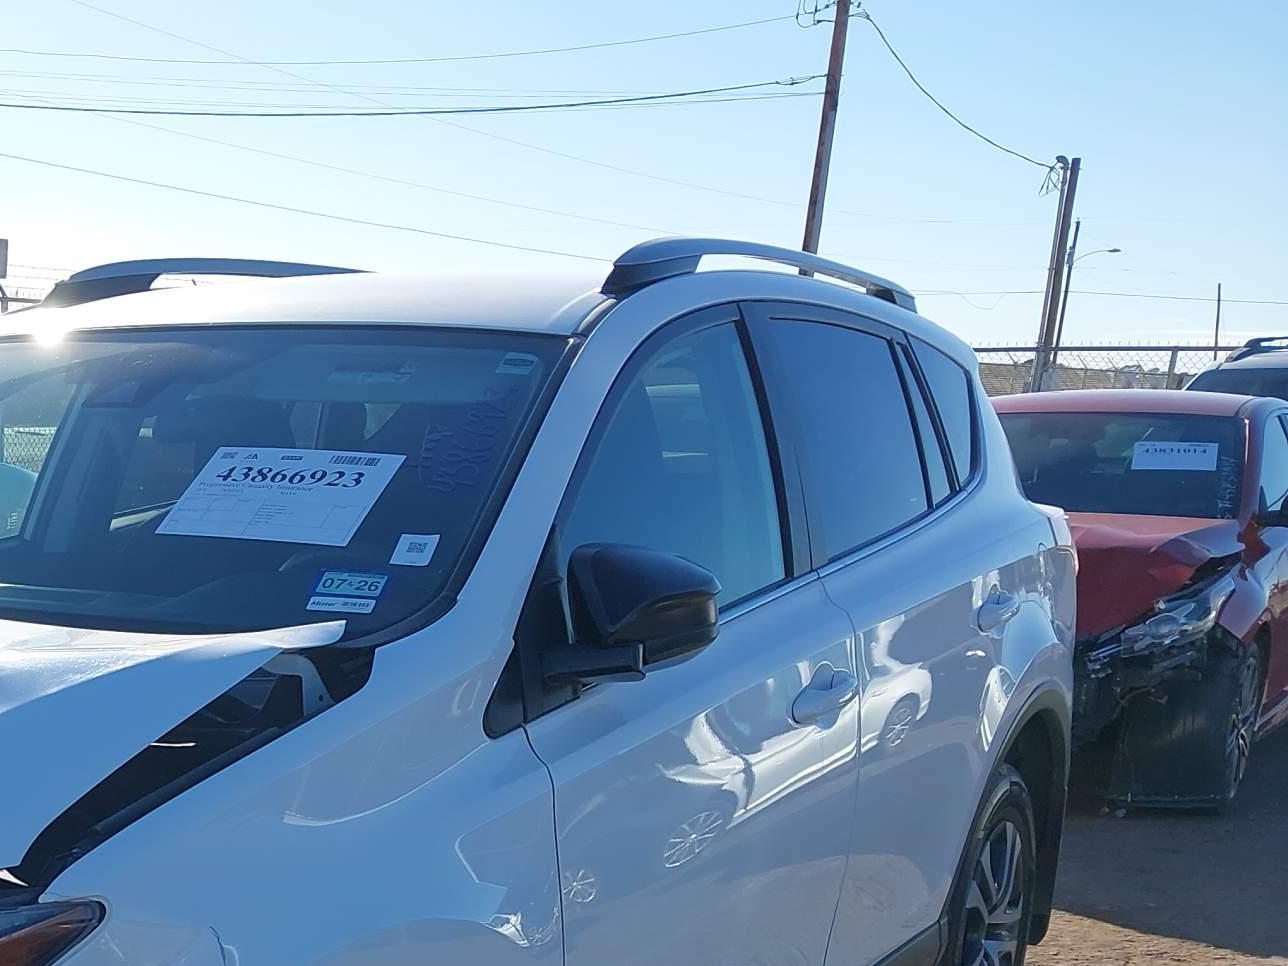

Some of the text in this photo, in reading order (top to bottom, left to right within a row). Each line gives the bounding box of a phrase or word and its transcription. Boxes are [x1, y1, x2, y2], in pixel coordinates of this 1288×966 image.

[216, 465, 366, 488] 43866923
[322, 577, 381, 592] 07 26
